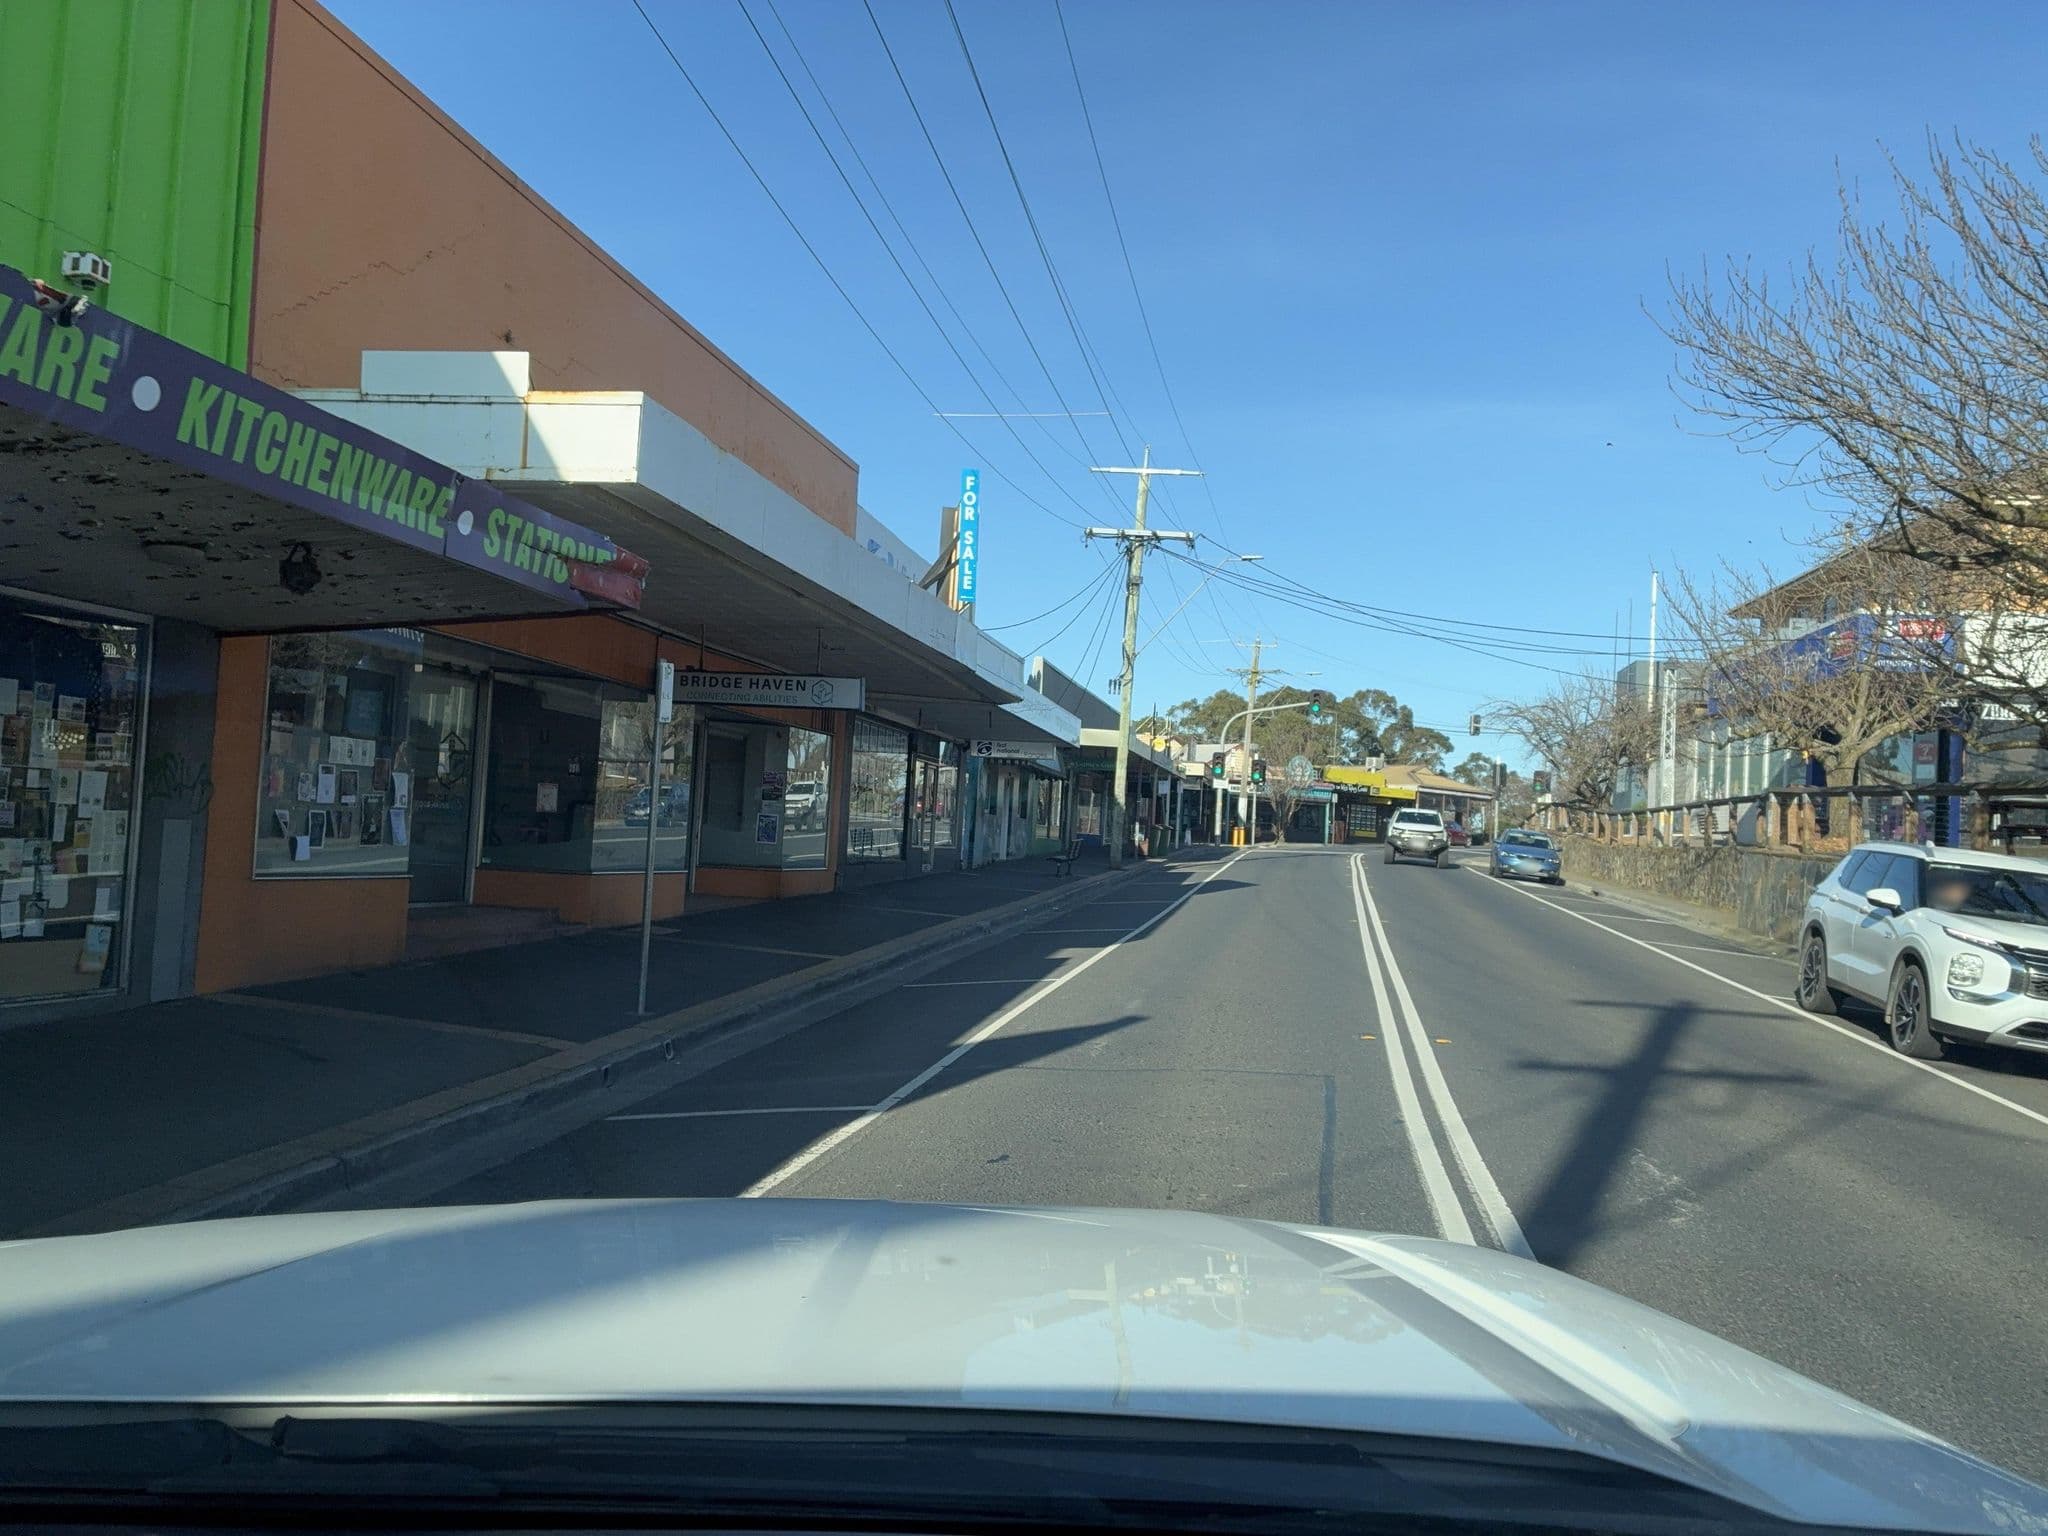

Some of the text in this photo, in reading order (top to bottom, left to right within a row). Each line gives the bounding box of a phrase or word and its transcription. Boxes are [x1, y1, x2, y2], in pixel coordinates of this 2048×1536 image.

[0, 293, 121, 413] ARE
[176, 377, 456, 539] KITCHENWARE
[963, 476, 976, 589] FOR SALE
[679, 674, 806, 692] BRIDGE HAVEN
[686, 691, 799, 704] CONNECTING ABILITIES
